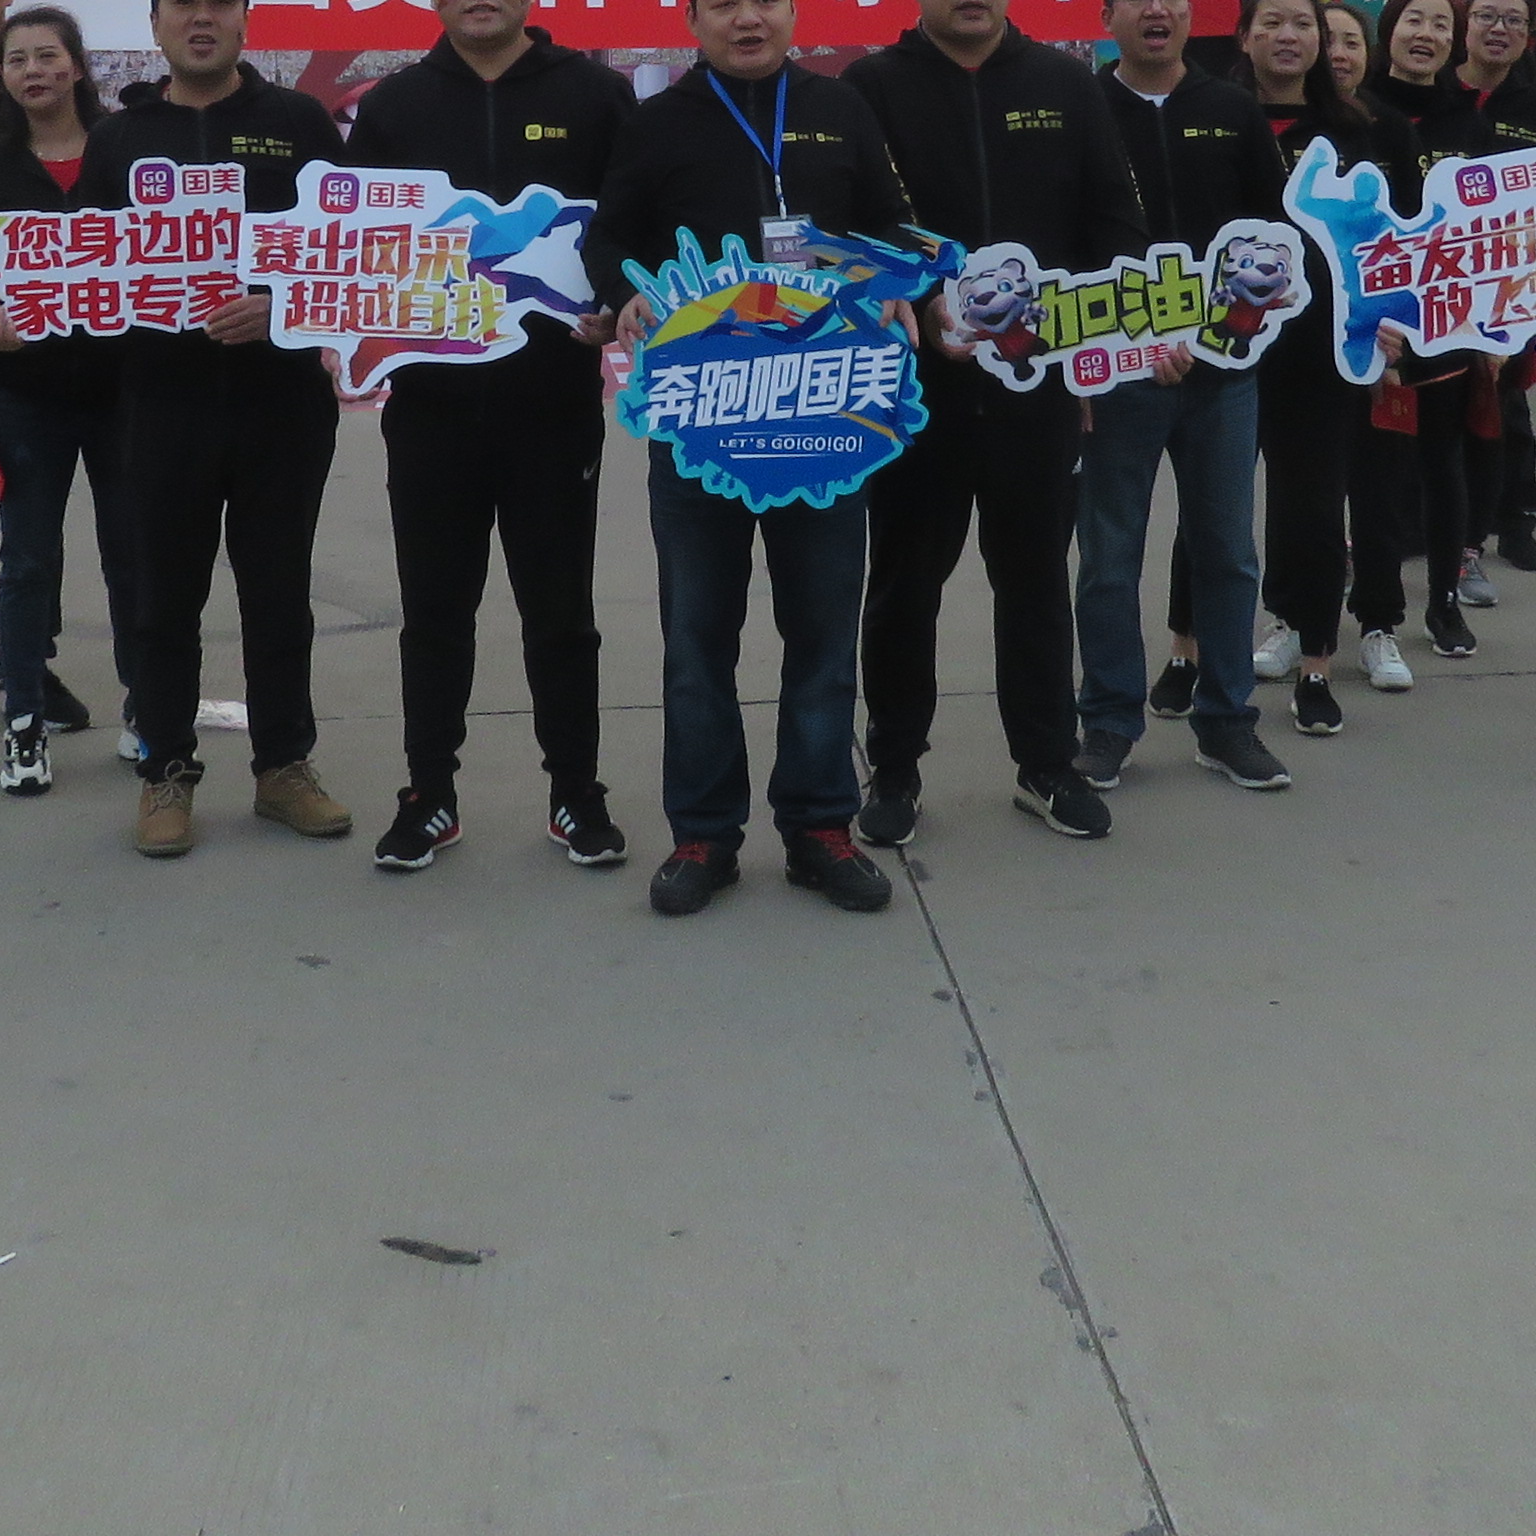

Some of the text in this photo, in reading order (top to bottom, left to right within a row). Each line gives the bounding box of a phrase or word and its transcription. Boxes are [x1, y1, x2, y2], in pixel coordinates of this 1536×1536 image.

[141, 170, 168, 184] GO
[181, 168, 241, 196] 国美
[1462, 170, 1488, 186] GO
[142, 185, 168, 198] ME
[327, 179, 353, 193] GO
[1464, 186, 1490, 200] ME
[327, 194, 352, 207] ME
[366, 182, 426, 210] 国美
[3, 208, 242, 271] 您身边的
[249, 218, 472, 284] 赛出风采
[5, 270, 244, 336] 家电专家
[284, 272, 511, 345] 超越自我
[1079, 353, 1103, 368] GO
[1080, 367, 1104, 380] ME
[647, 342, 904, 433] 奔跑吧国美
